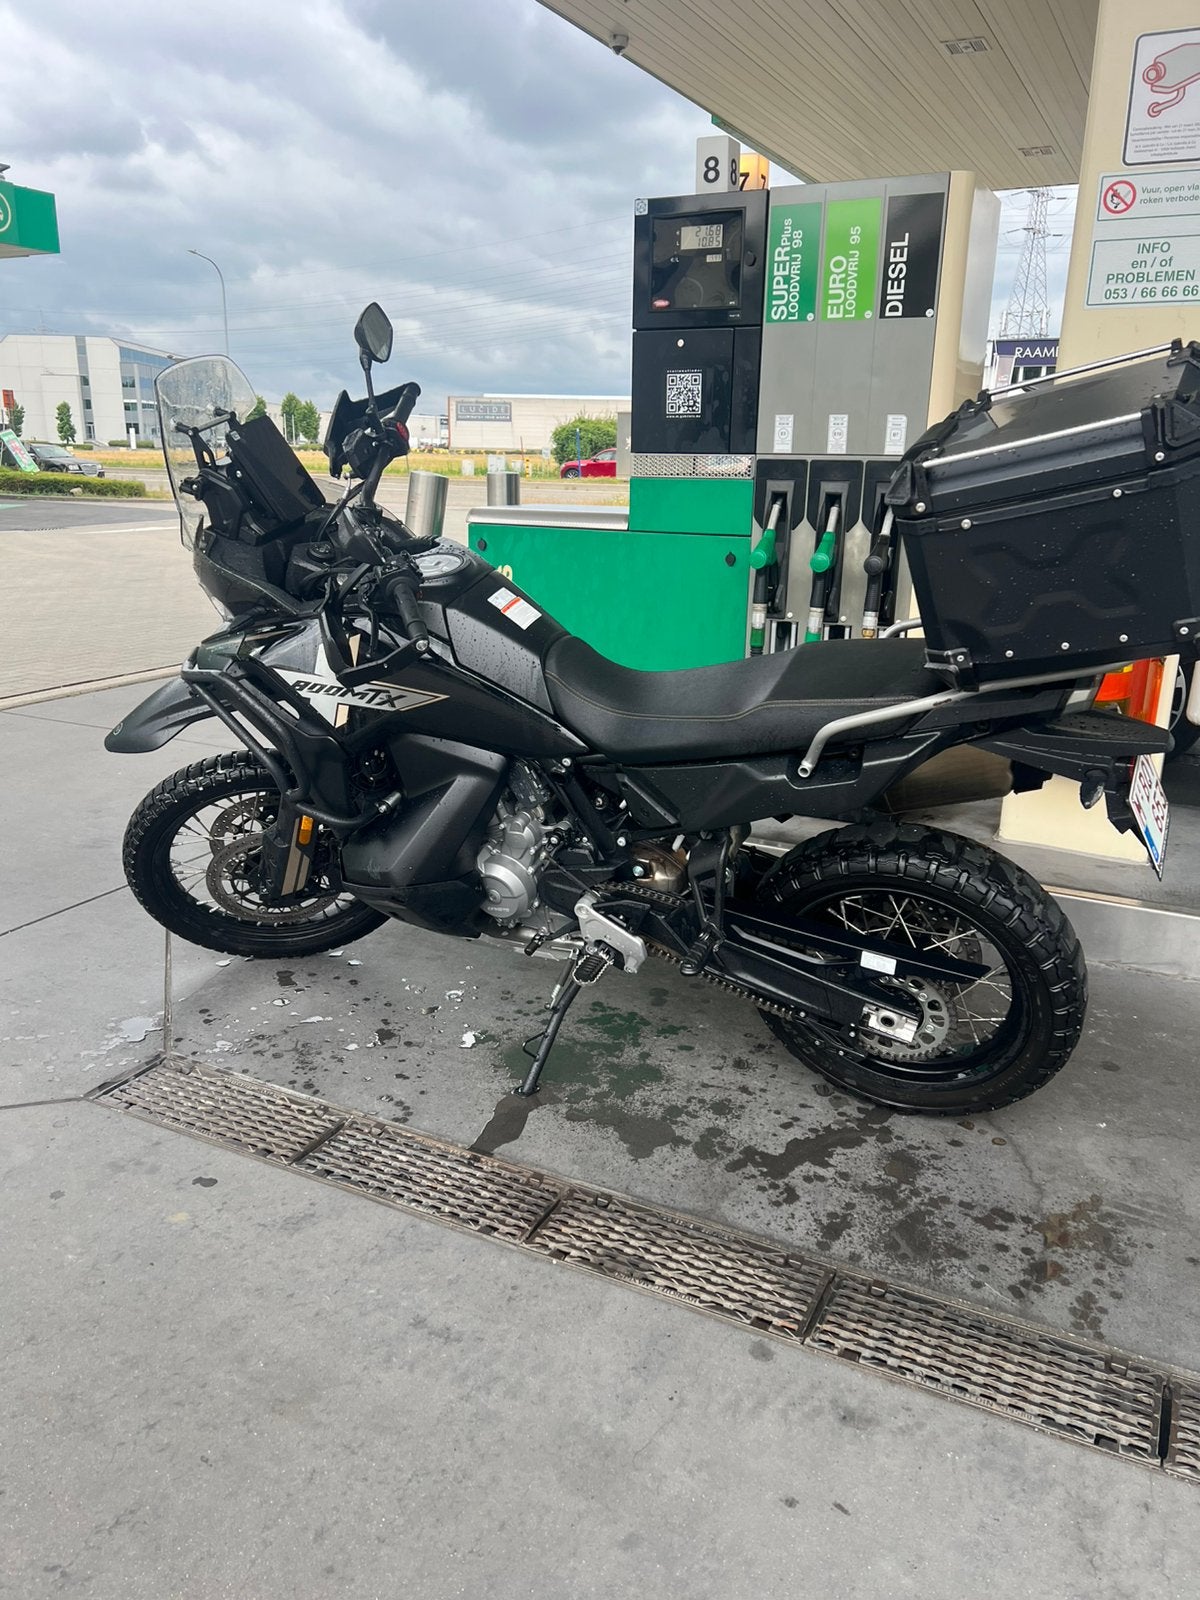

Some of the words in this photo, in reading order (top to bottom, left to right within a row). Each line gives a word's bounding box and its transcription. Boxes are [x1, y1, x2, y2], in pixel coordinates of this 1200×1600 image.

[703, 155, 720, 184] 8
[730, 158, 737, 186] 8
[739, 172, 750, 191] 7
[1141, 186, 1162, 195] Vuur,
[1164, 184, 1185, 194] open
[1140, 196, 1163, 205] roken
[1165, 194, 1200, 204] verbode
[792, 229, 803, 249] 98
[850, 226, 861, 245] 95
[1137, 241, 1171, 255] INFO
[1131, 260, 1147, 269] en
[1150, 256, 1157, 268] /
[1159, 256, 1174, 268] of
[845, 250, 860, 318] LOODVRIJ
[884, 232, 910, 317] DIESEL
[1106, 269, 1196, 284] PROBLEMEN
[788, 253, 803, 321] LOODVRIJ
[827, 255, 847, 319] EURO
[1104, 287, 1128, 300] 053
[1131, 287, 1138, 299] /
[1140, 286, 1157, 298] 66
[1161, 285, 1178, 298] 66
[1182, 284, 1199, 297] 66
